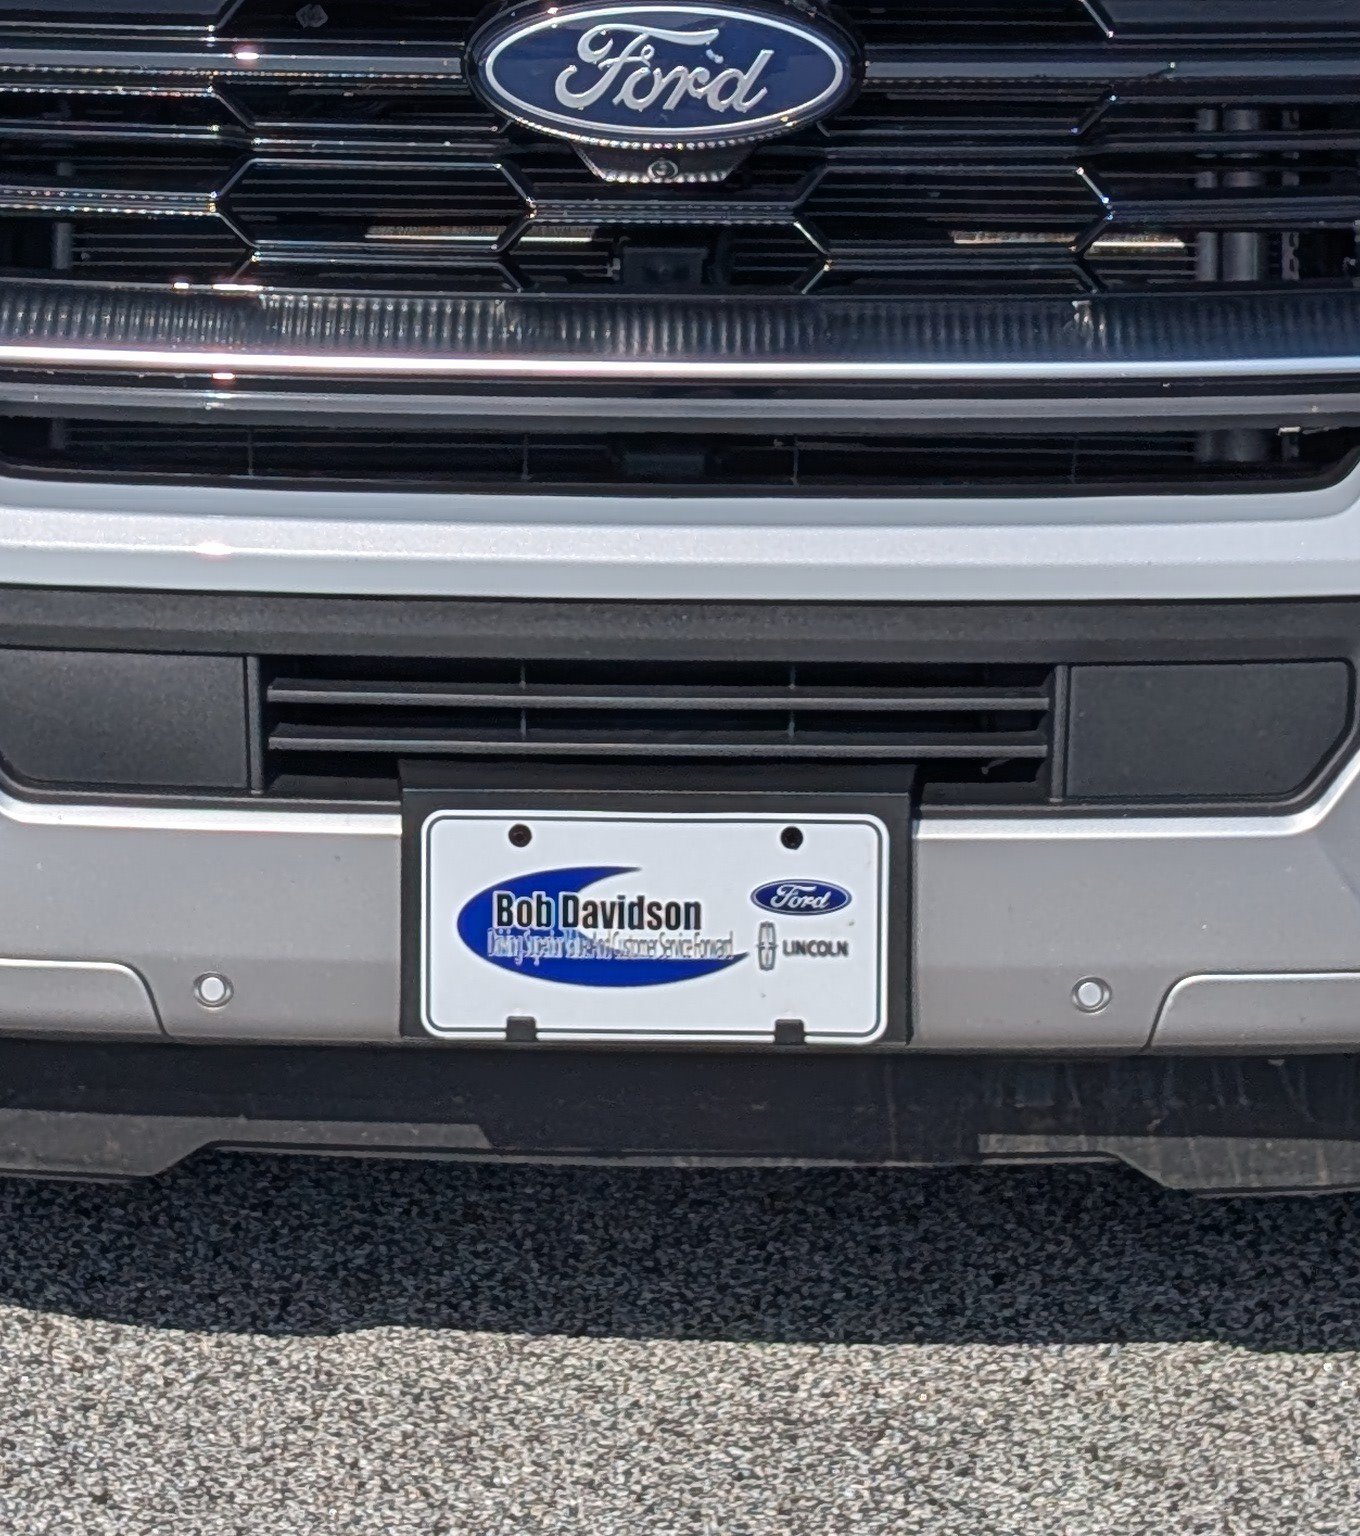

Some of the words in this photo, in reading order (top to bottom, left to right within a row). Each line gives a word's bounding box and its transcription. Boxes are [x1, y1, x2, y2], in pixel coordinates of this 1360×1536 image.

[554, 21, 776, 114] Ford
[495, 892, 555, 928] Bob
[561, 894, 702, 931] Davidson
[770, 883, 832, 909] Ford
[782, 939, 849, 957] LINCOLN
